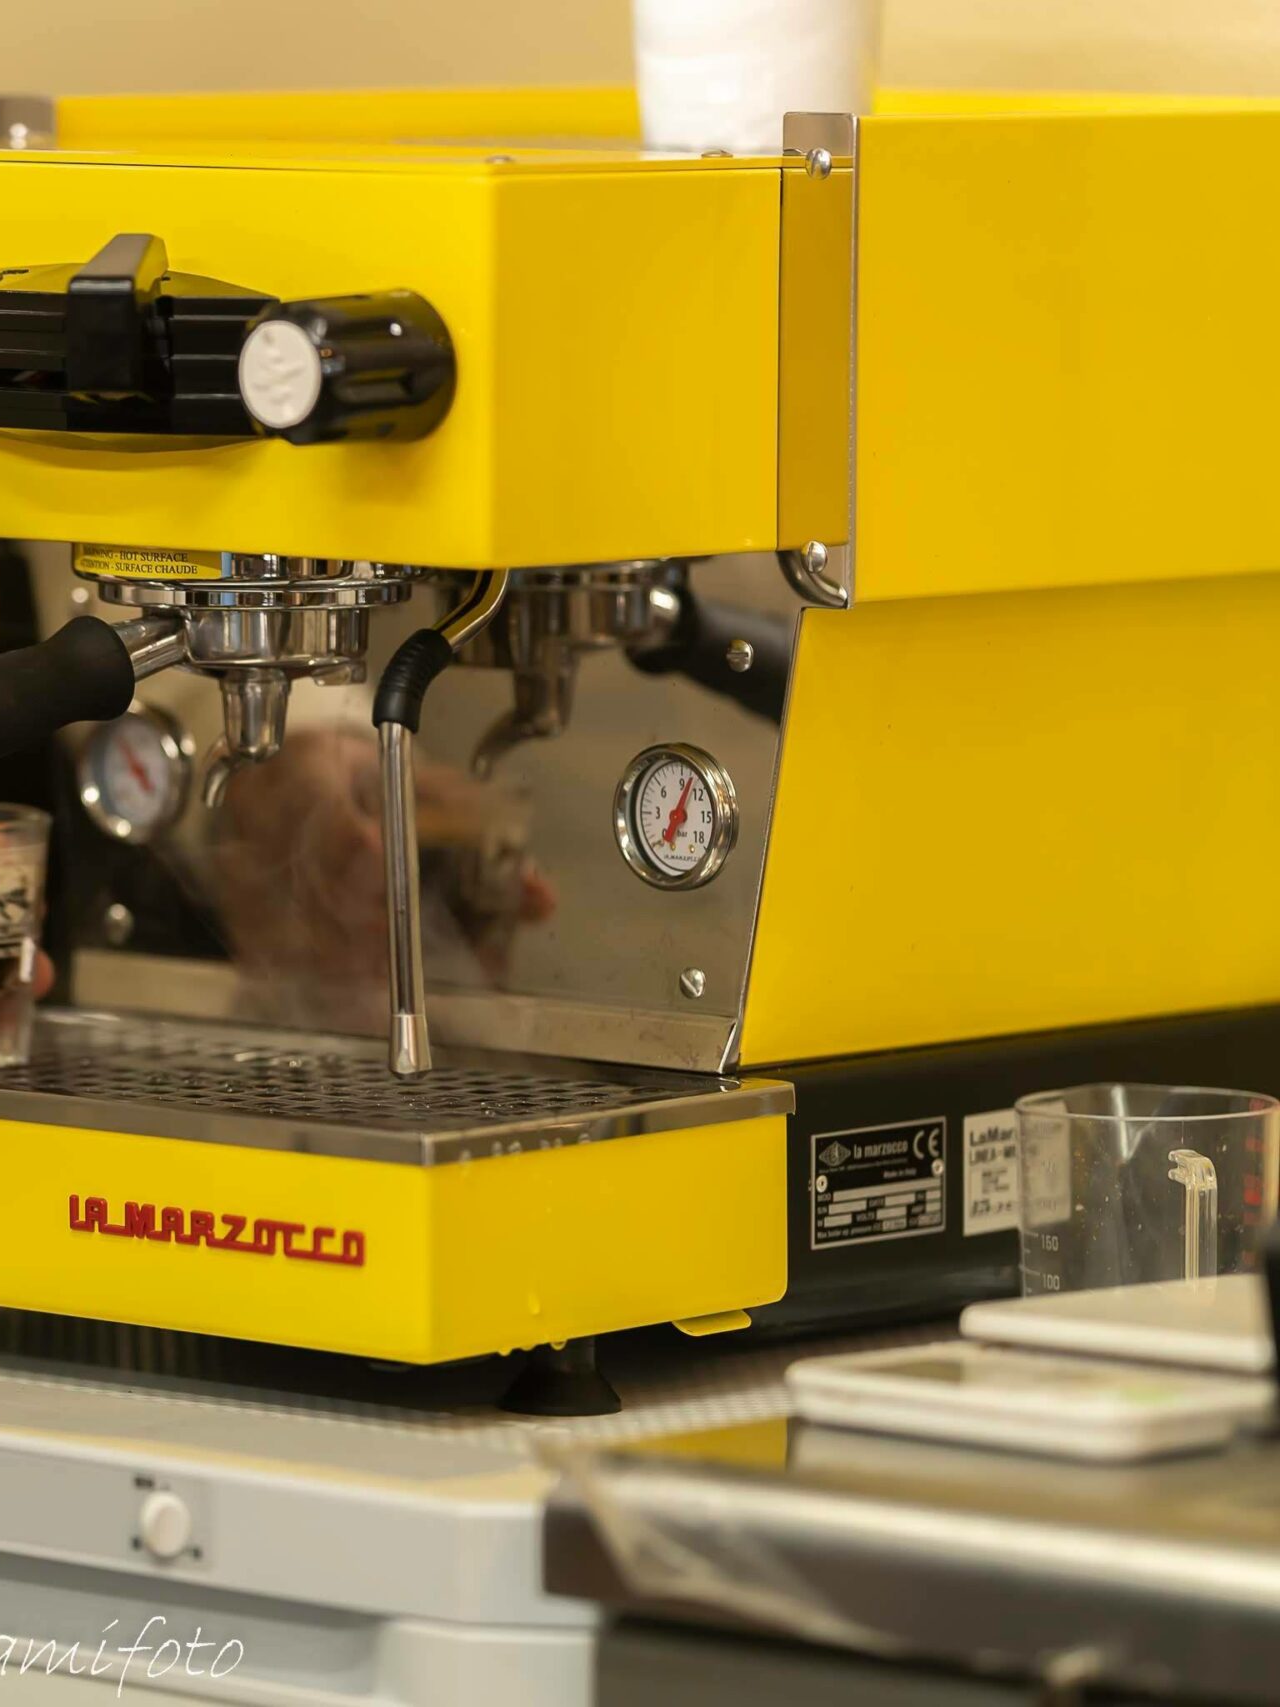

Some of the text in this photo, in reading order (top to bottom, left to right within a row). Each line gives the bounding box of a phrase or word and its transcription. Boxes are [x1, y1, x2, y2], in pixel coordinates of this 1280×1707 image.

[120, 551, 137, 562] HOT
[140, 552, 188, 562] SURFACE
[115, 562, 153, 573] SURFACE
[155, 564, 198, 575] CHAUDE
[679, 778, 685, 790] 9
[660, 786, 667, 799] 6
[693, 788, 704, 801] 12
[655, 806, 661, 819] 3
[701, 811, 712, 824] 15
[693, 830, 705, 844] 18
[853, 1143, 862, 1160] la
[864, 1140, 908, 1159] marzocco
[69, 1194, 365, 1267] LA MARZOCCO
[1042, 1273, 1060, 1290] 100
